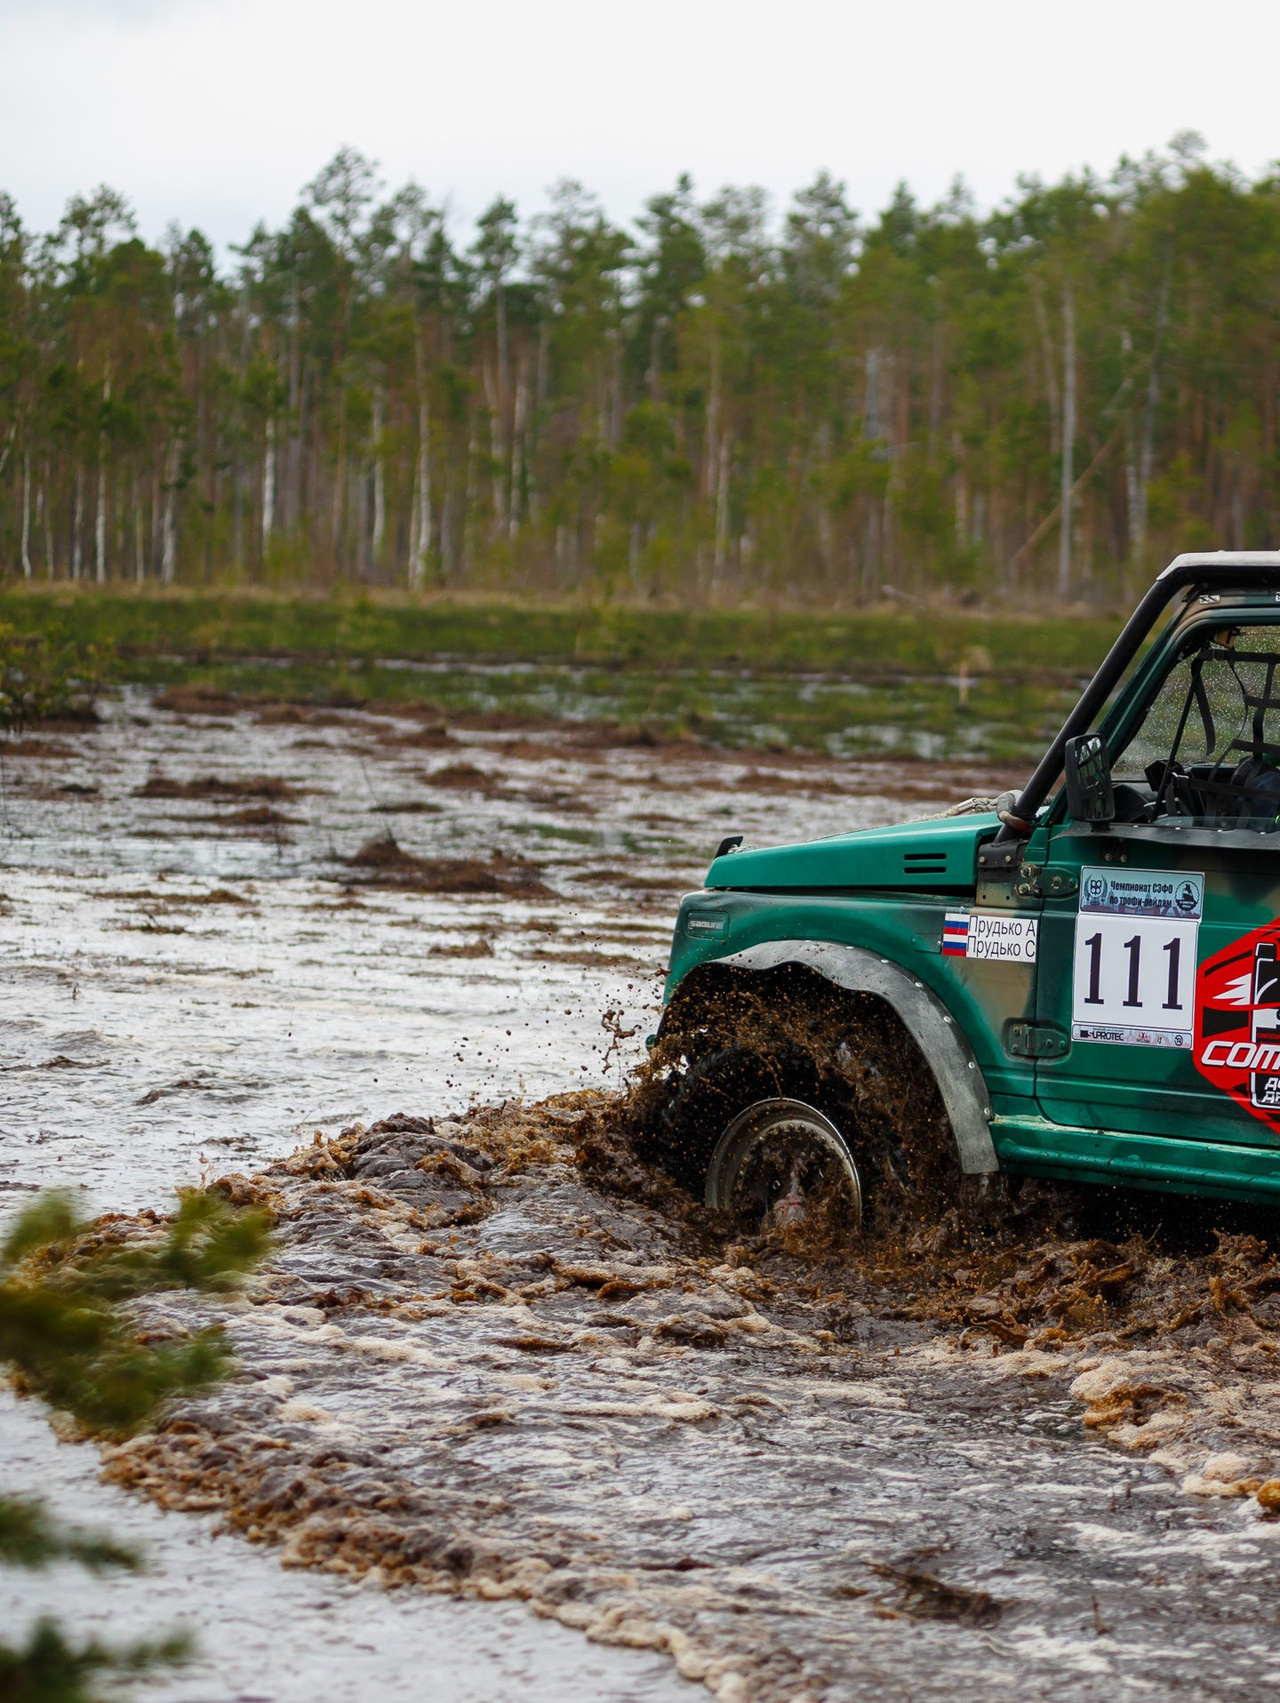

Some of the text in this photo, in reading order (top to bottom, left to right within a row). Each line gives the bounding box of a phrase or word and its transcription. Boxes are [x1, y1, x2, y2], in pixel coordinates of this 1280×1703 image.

[1110, 880, 1173, 894] Чемпионат СЗФО
[1109, 896, 1119, 905] по
[968, 916, 1036, 938] Прудько А
[967, 936, 1036, 958] Прудько С
[1084, 932, 1183, 1010] 111
[1086, 1030, 1124, 1041] SUPROTEC
